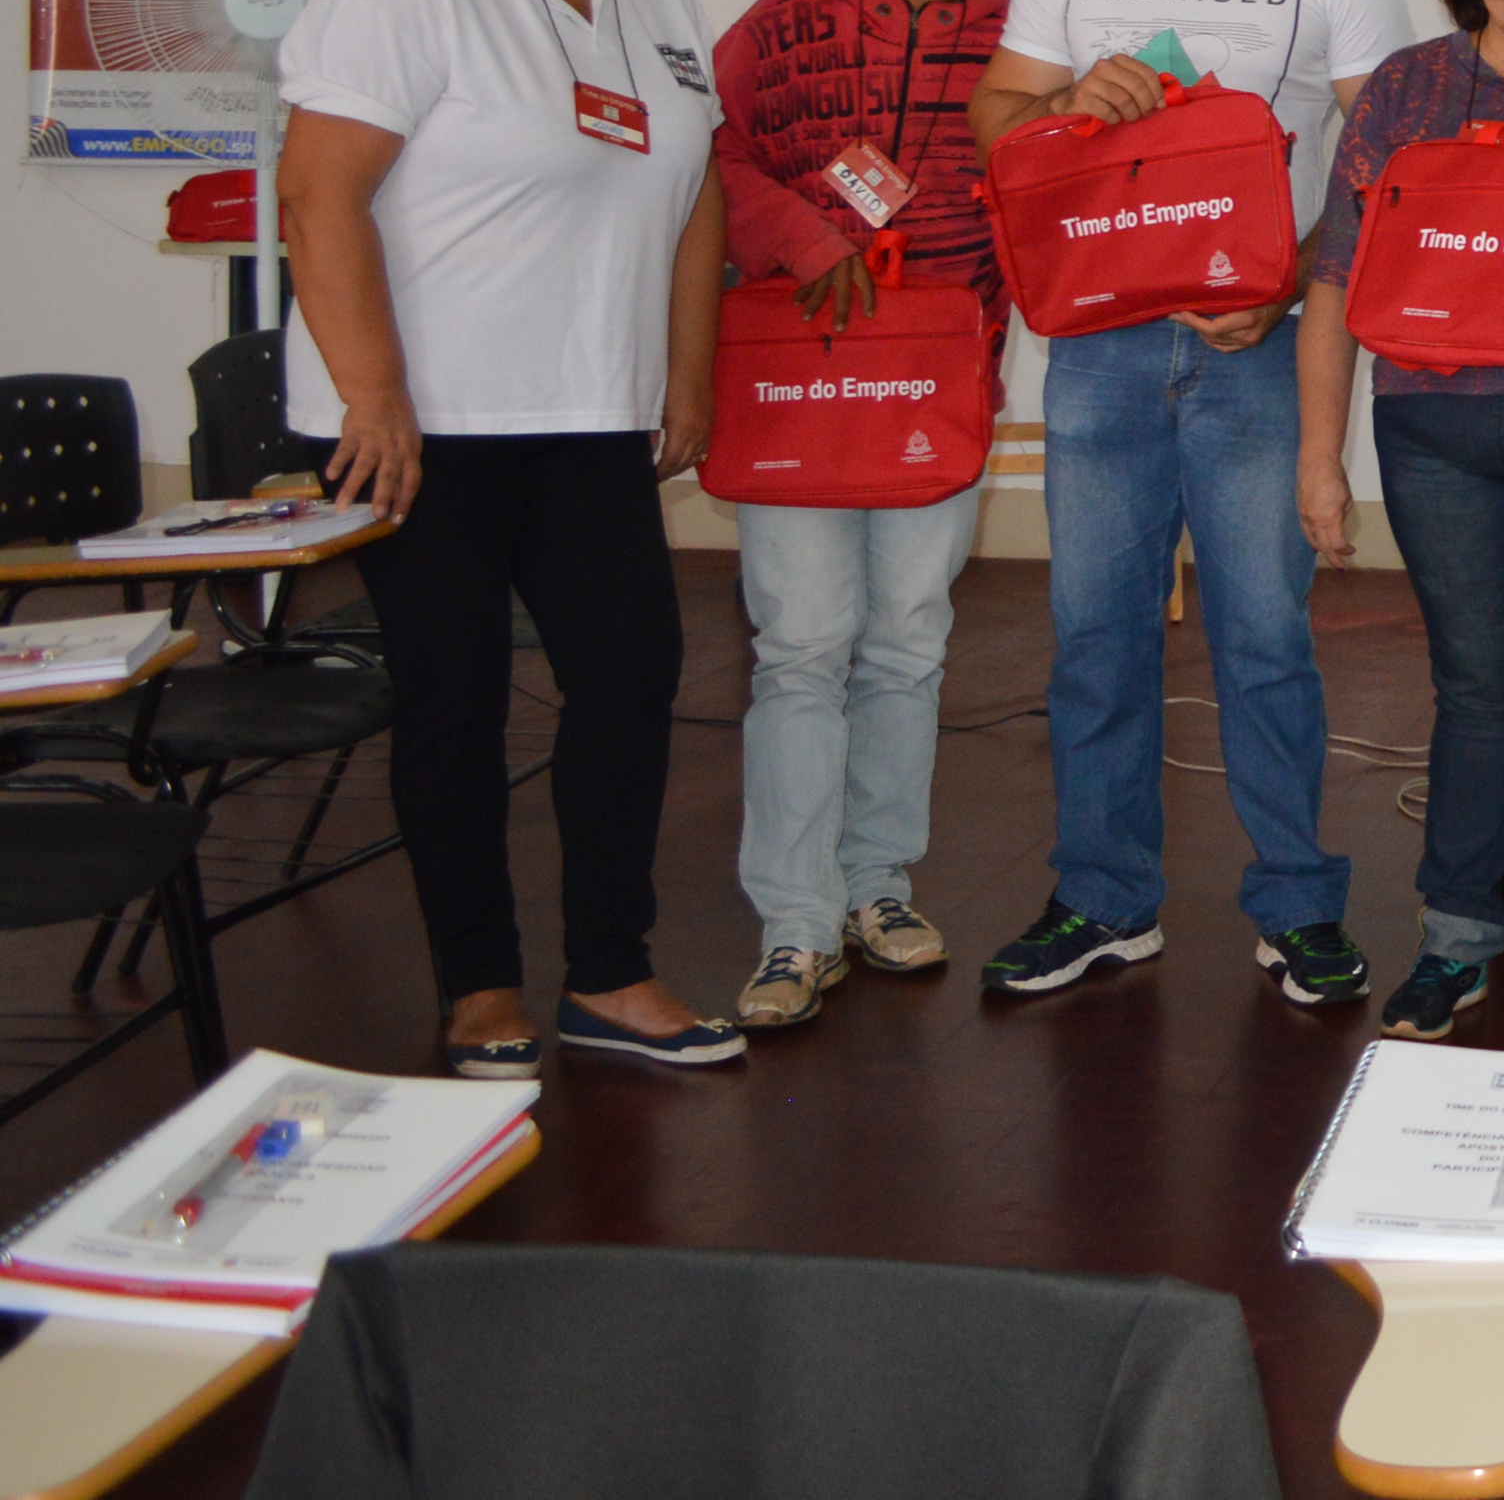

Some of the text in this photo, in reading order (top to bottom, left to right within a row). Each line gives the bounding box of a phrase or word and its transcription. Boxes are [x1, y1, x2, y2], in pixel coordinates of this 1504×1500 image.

[1060, 196, 1234, 239] Time do Emprego
[1419, 228, 1467, 251] Time
[1471, 231, 1499, 253] do
[755, 377, 936, 403] Time do Emprego
